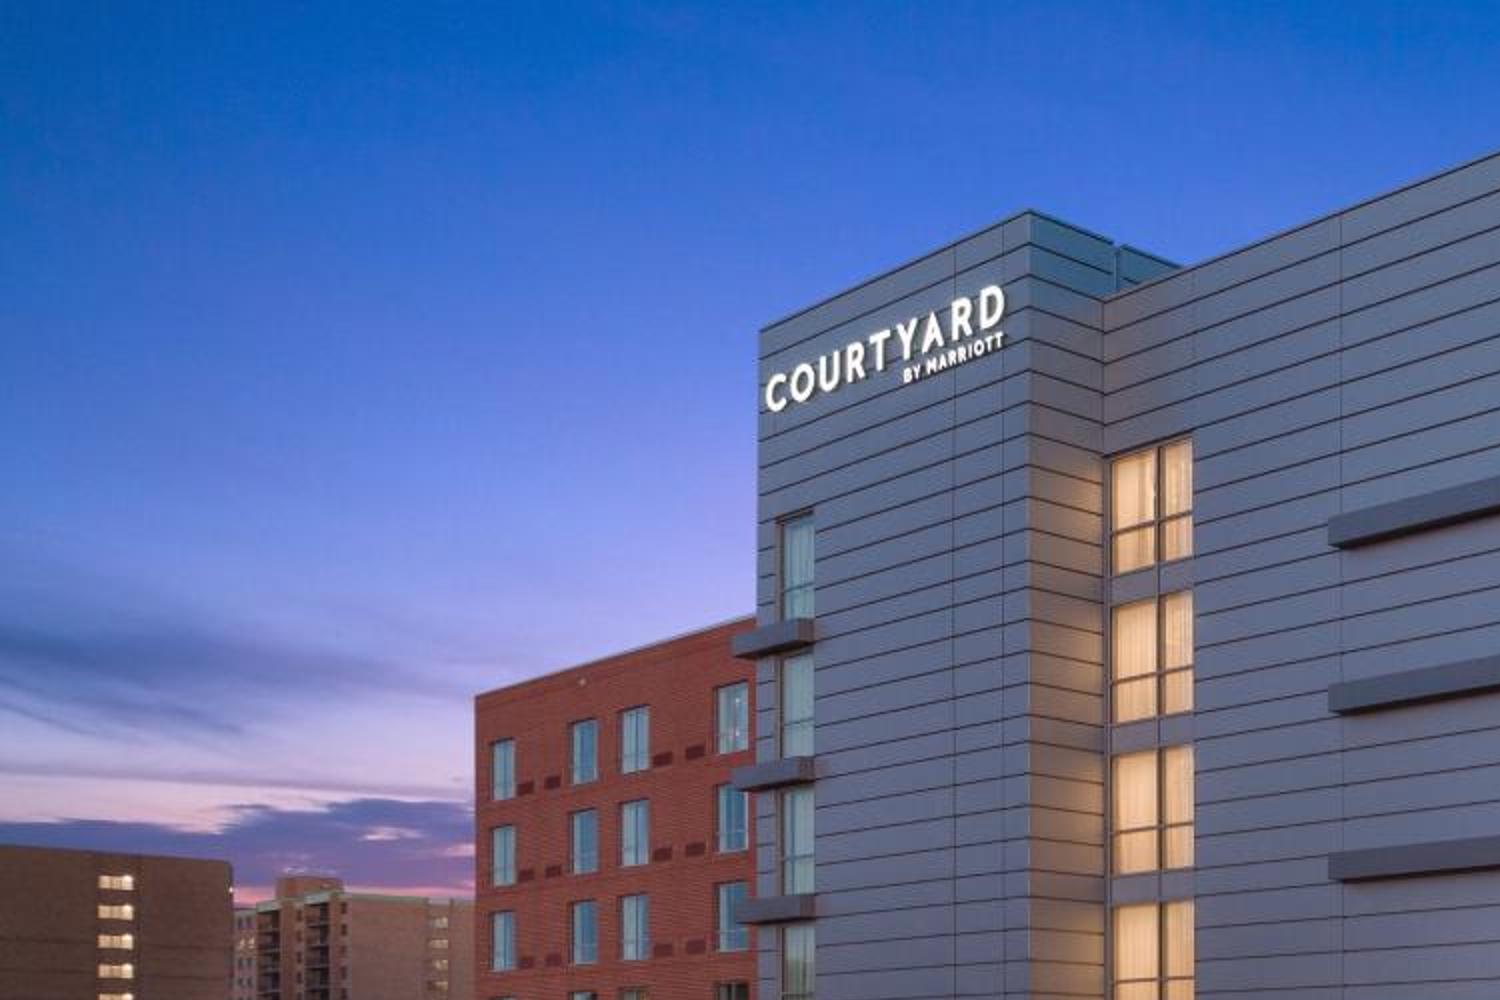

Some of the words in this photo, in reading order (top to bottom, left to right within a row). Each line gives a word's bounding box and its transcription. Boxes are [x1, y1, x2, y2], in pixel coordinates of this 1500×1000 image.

[765, 285, 1005, 412] COURTYARD
[903, 364, 921, 384] BY
[926, 331, 1004, 376] MARRIOTT
